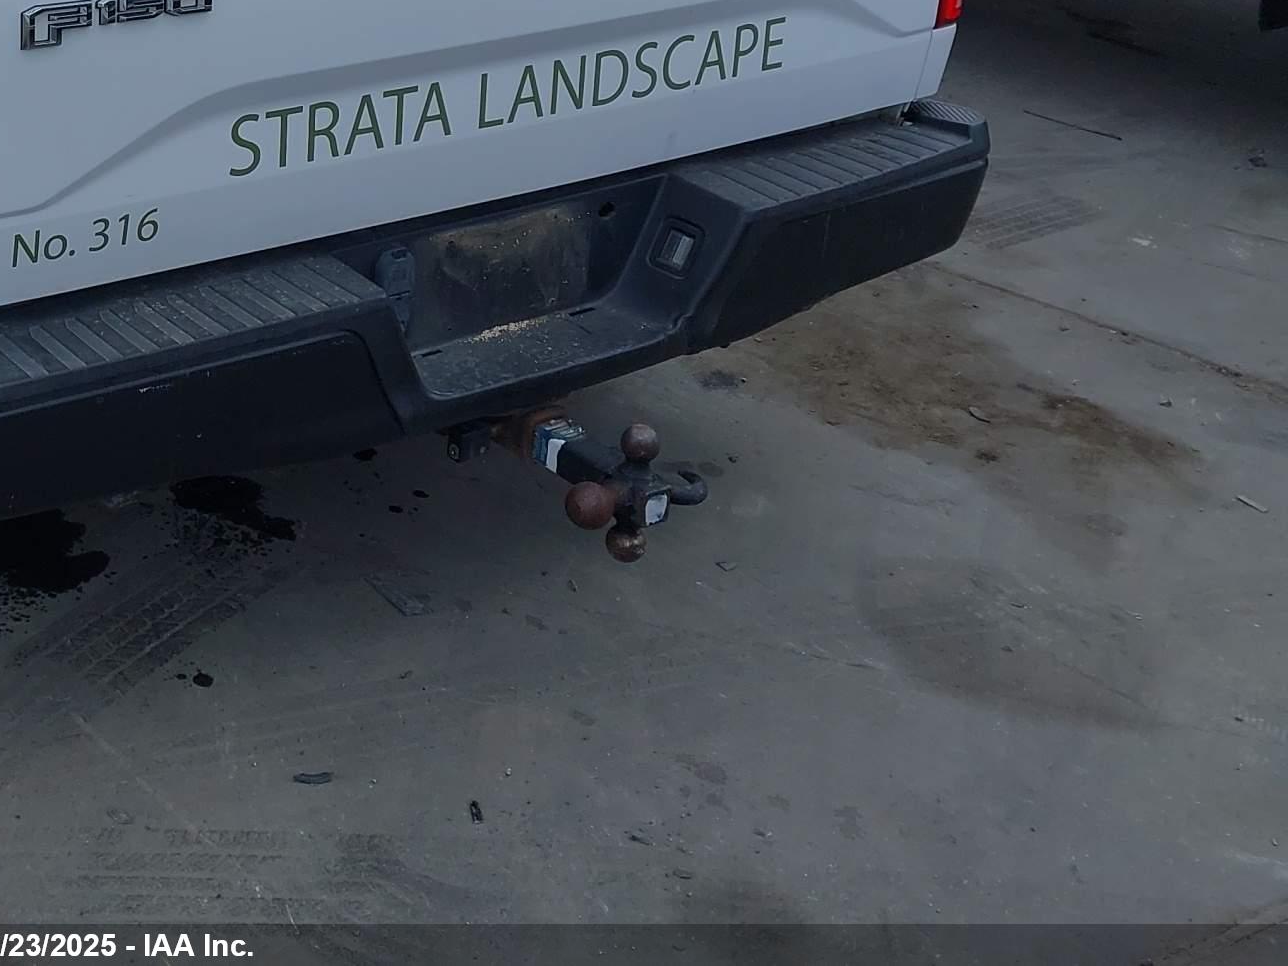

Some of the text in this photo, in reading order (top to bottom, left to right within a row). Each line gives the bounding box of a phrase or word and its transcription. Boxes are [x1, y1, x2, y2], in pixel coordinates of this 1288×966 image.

[229, 16, 788, 177] STRATA LANDSCAPE
[12, 208, 160, 268] No. 316
